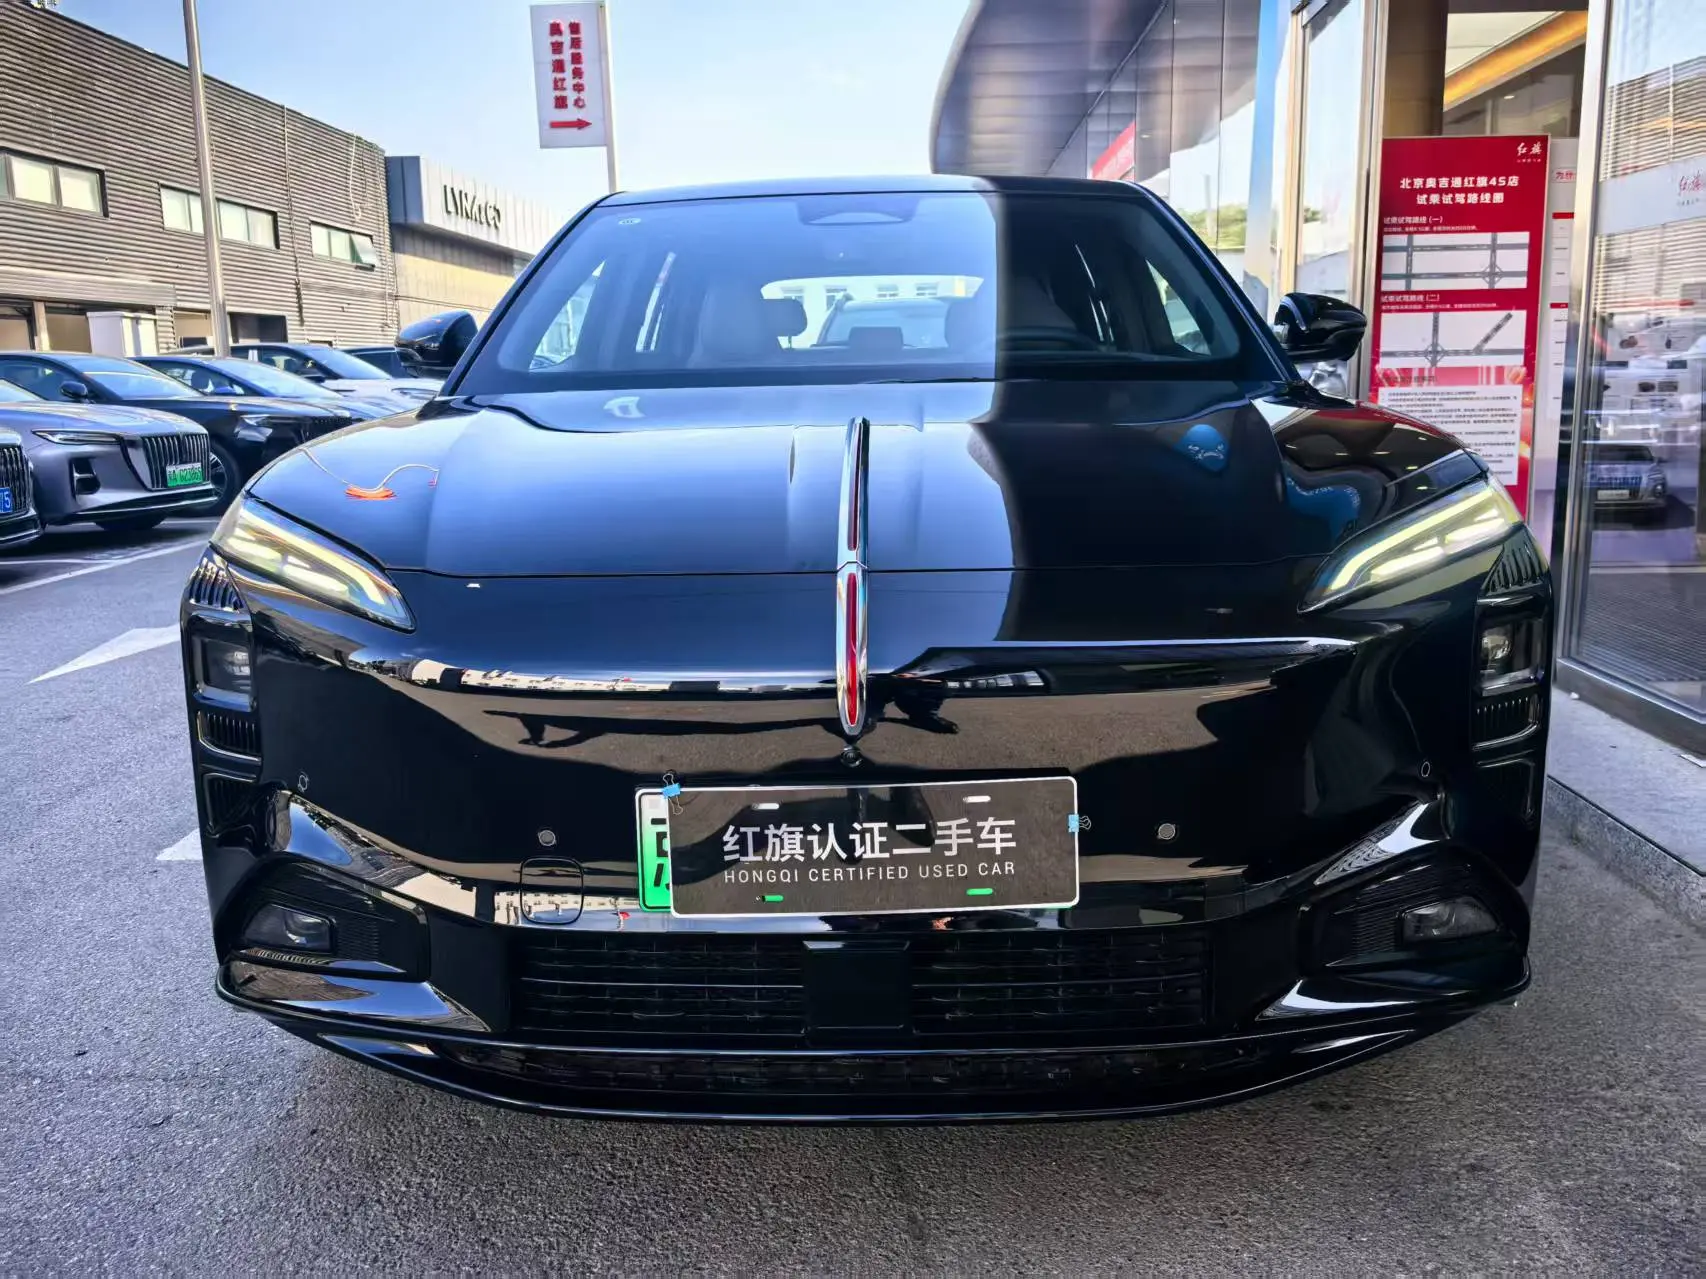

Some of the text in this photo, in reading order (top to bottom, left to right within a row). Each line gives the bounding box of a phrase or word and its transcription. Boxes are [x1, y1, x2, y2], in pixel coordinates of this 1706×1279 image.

[1516, 141, 1542, 156] 红旗
[1399, 175, 1520, 189] 北京奥吉通红旗4S店
[1416, 192, 1504, 205] 试乘试驾路线图
[722, 817, 1017, 863] 红旗认证二手车
[723, 861, 1016, 884] HONGQI CERTIFIED USED CAR
